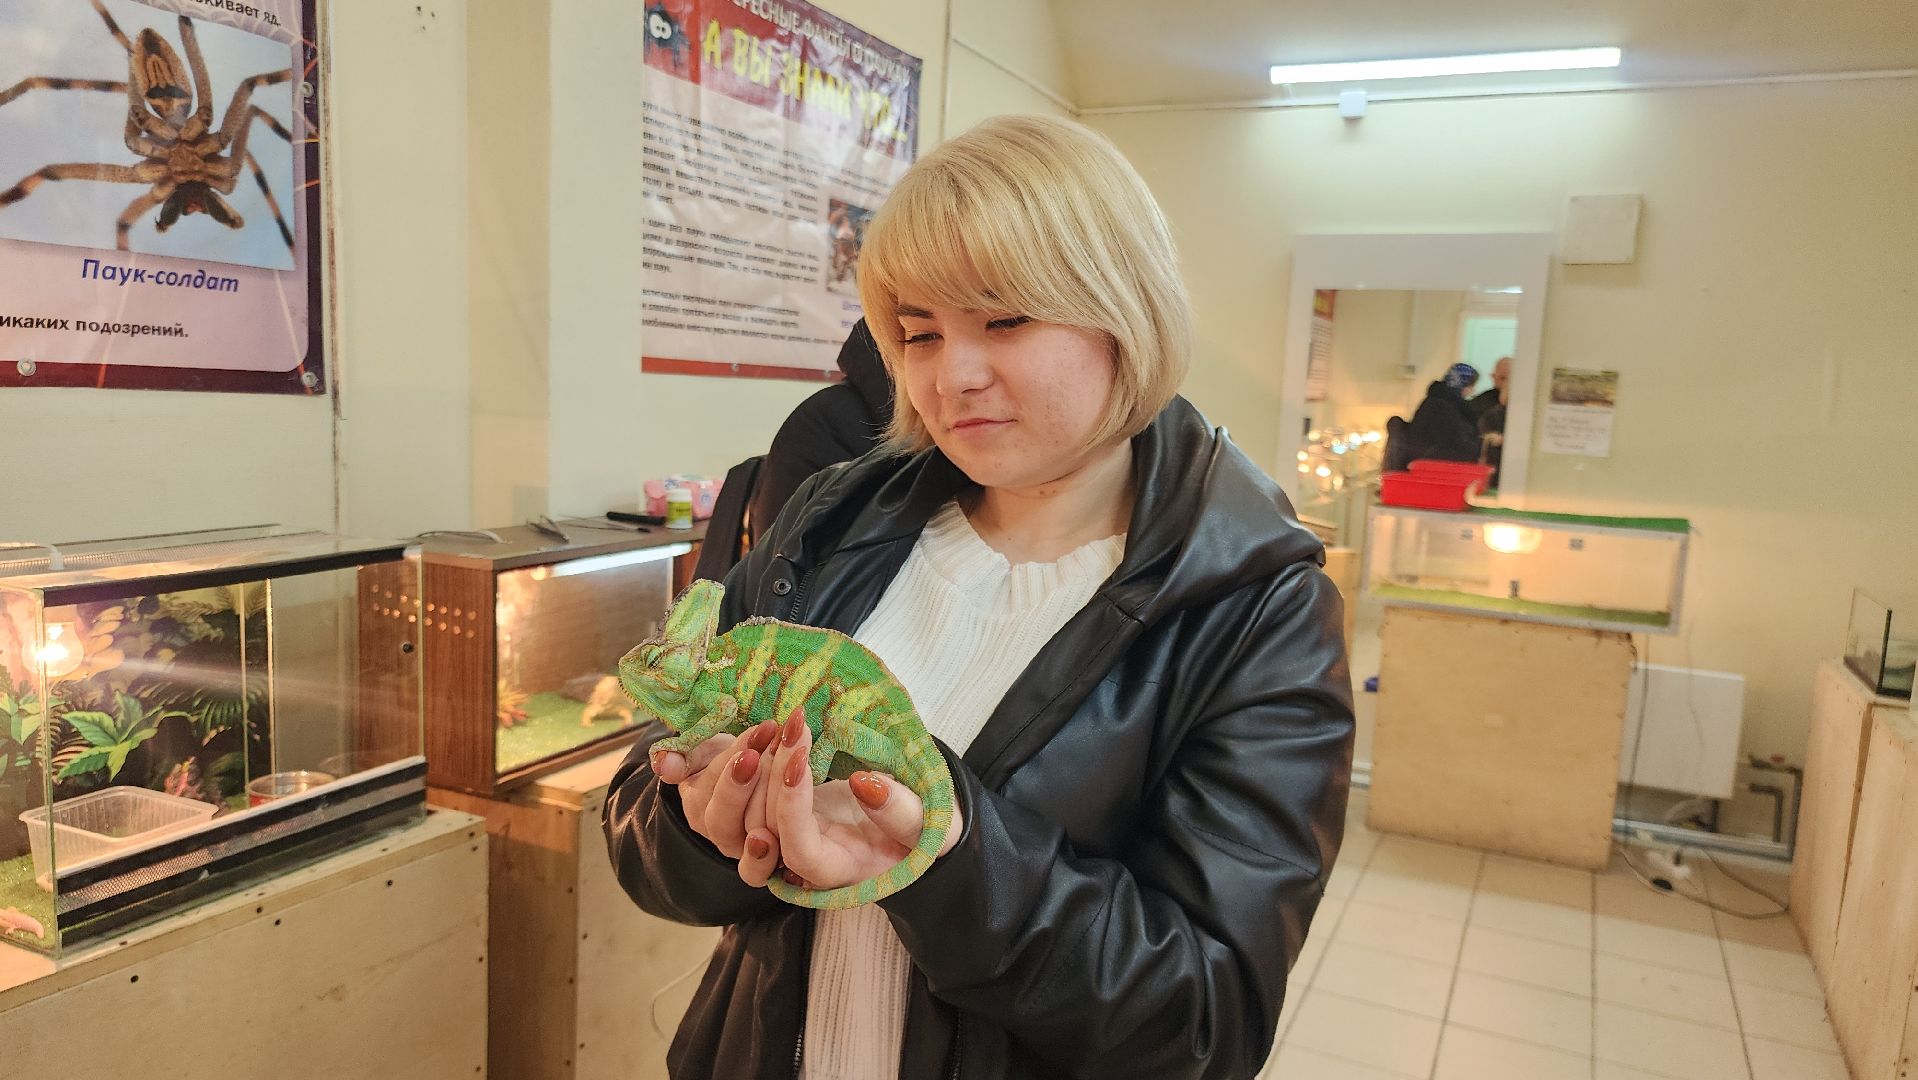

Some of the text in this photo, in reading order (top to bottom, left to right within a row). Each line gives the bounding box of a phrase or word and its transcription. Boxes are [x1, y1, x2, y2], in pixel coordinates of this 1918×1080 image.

[195, 0, 281, 27] кивает яд.
[703, 17, 722, 70] А
[733, 27, 772, 88] ВЫ
[81, 258, 240, 293] Паук-солдат
[0, 315, 190, 338] икаких подозрений.
